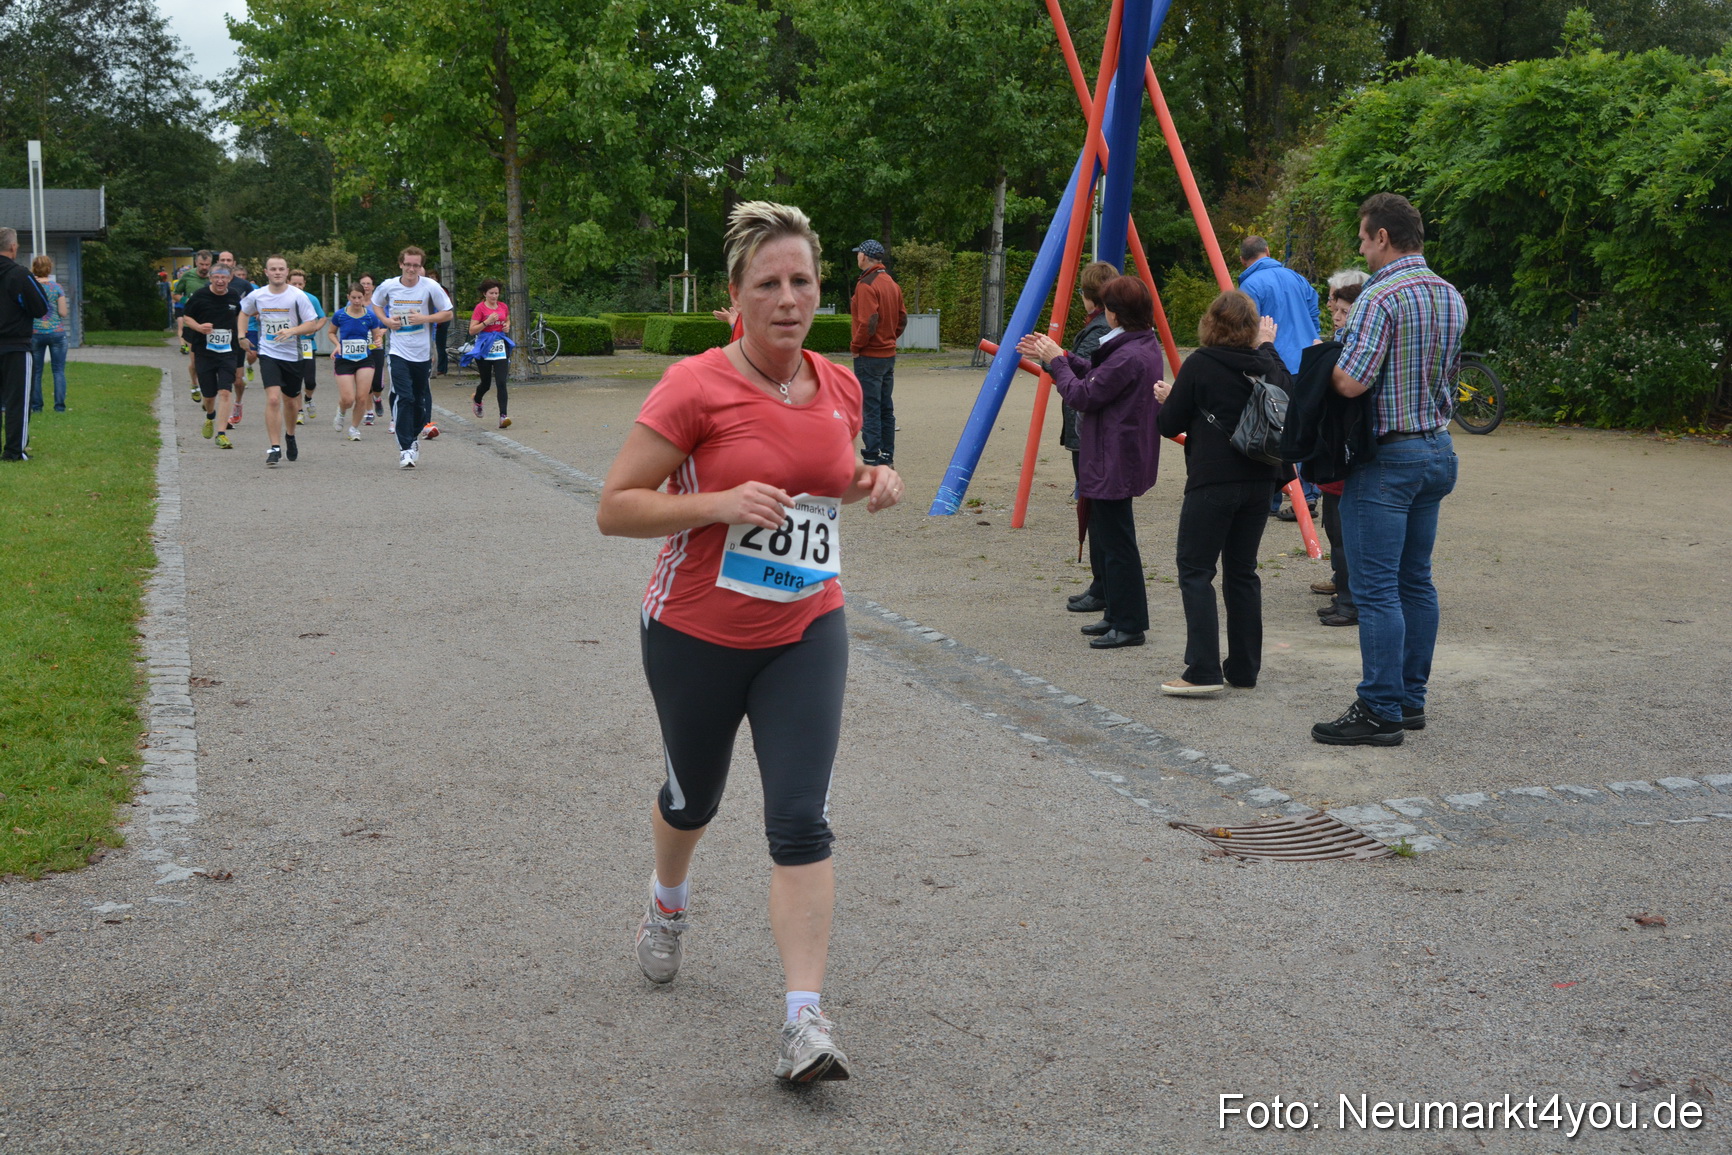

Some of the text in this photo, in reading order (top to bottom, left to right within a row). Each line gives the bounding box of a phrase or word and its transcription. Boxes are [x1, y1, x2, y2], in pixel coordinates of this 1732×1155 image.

[209, 334, 230, 344] 2947
[345, 344, 365, 354] 2045
[490, 344, 504, 353] 249
[740, 514, 830, 565] 2813
[763, 565, 805, 590] Petra
